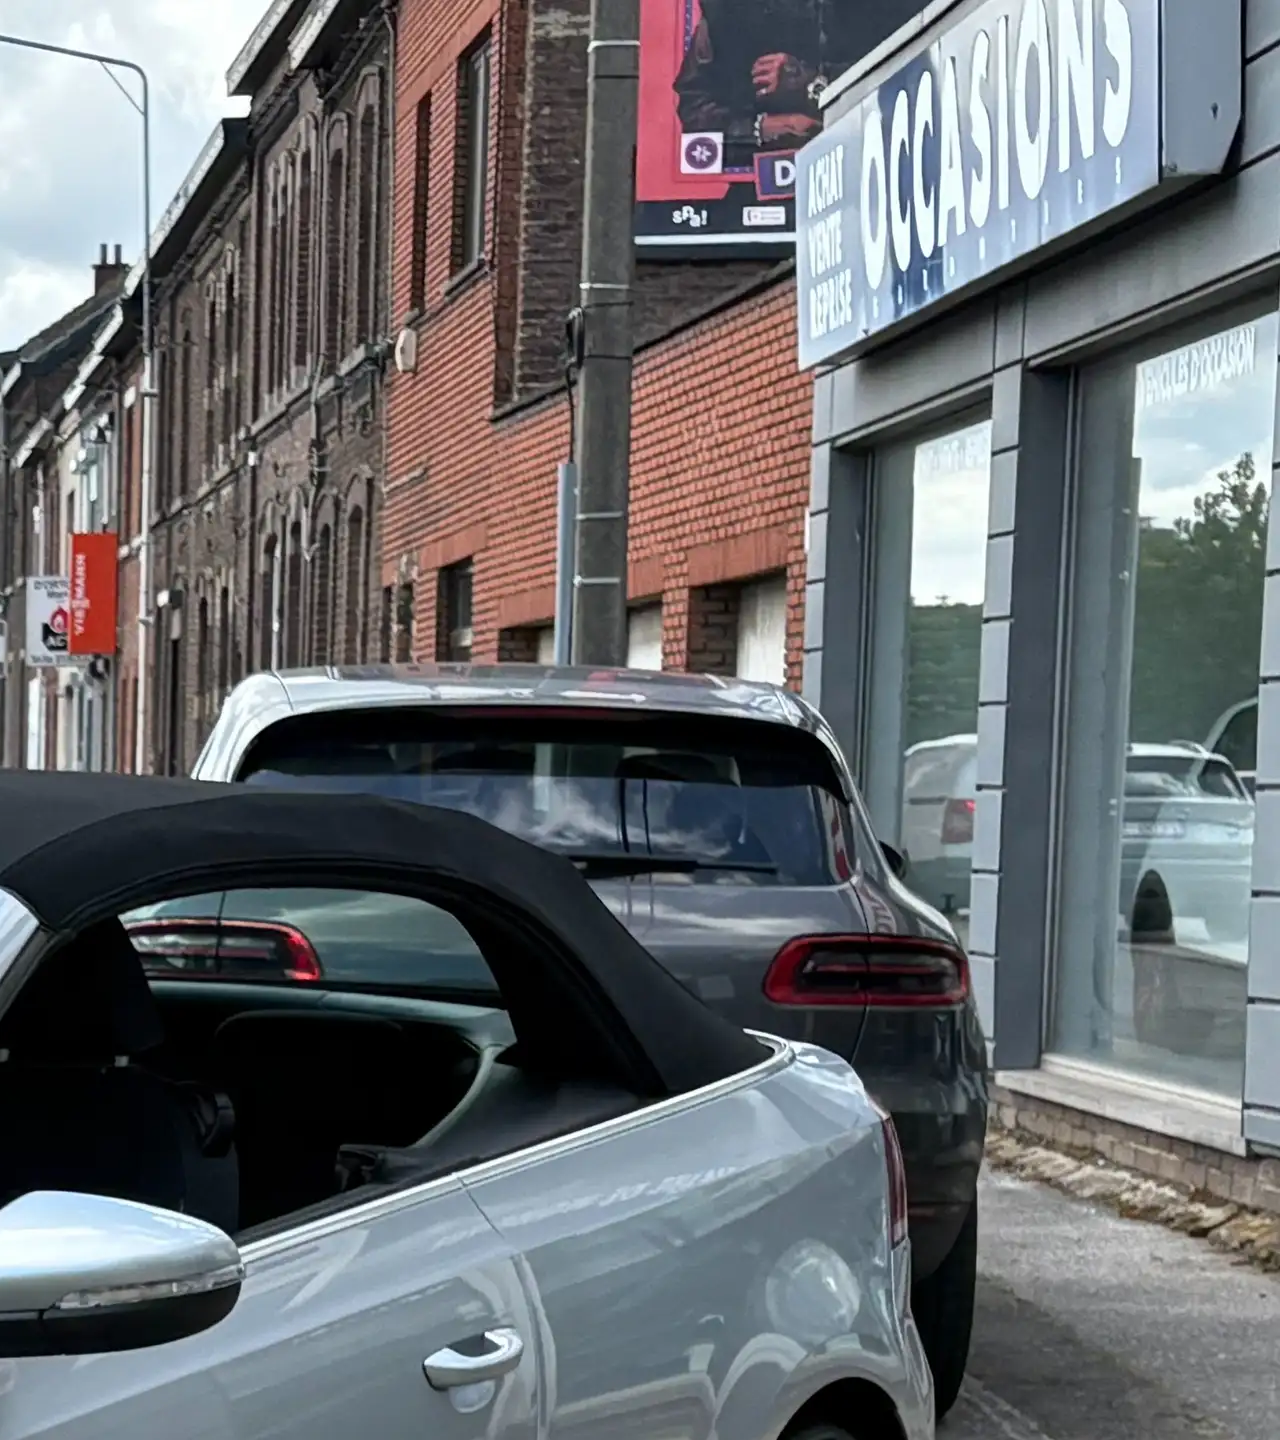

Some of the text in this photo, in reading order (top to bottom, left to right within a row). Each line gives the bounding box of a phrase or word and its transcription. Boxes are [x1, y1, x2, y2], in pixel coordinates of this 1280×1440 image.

[808, 144, 844, 219] ACHAT
[860, 0, 1132, 290] OCCASIONS
[808, 209, 842, 279] VENTE
[809, 267, 852, 341] REPRISE
